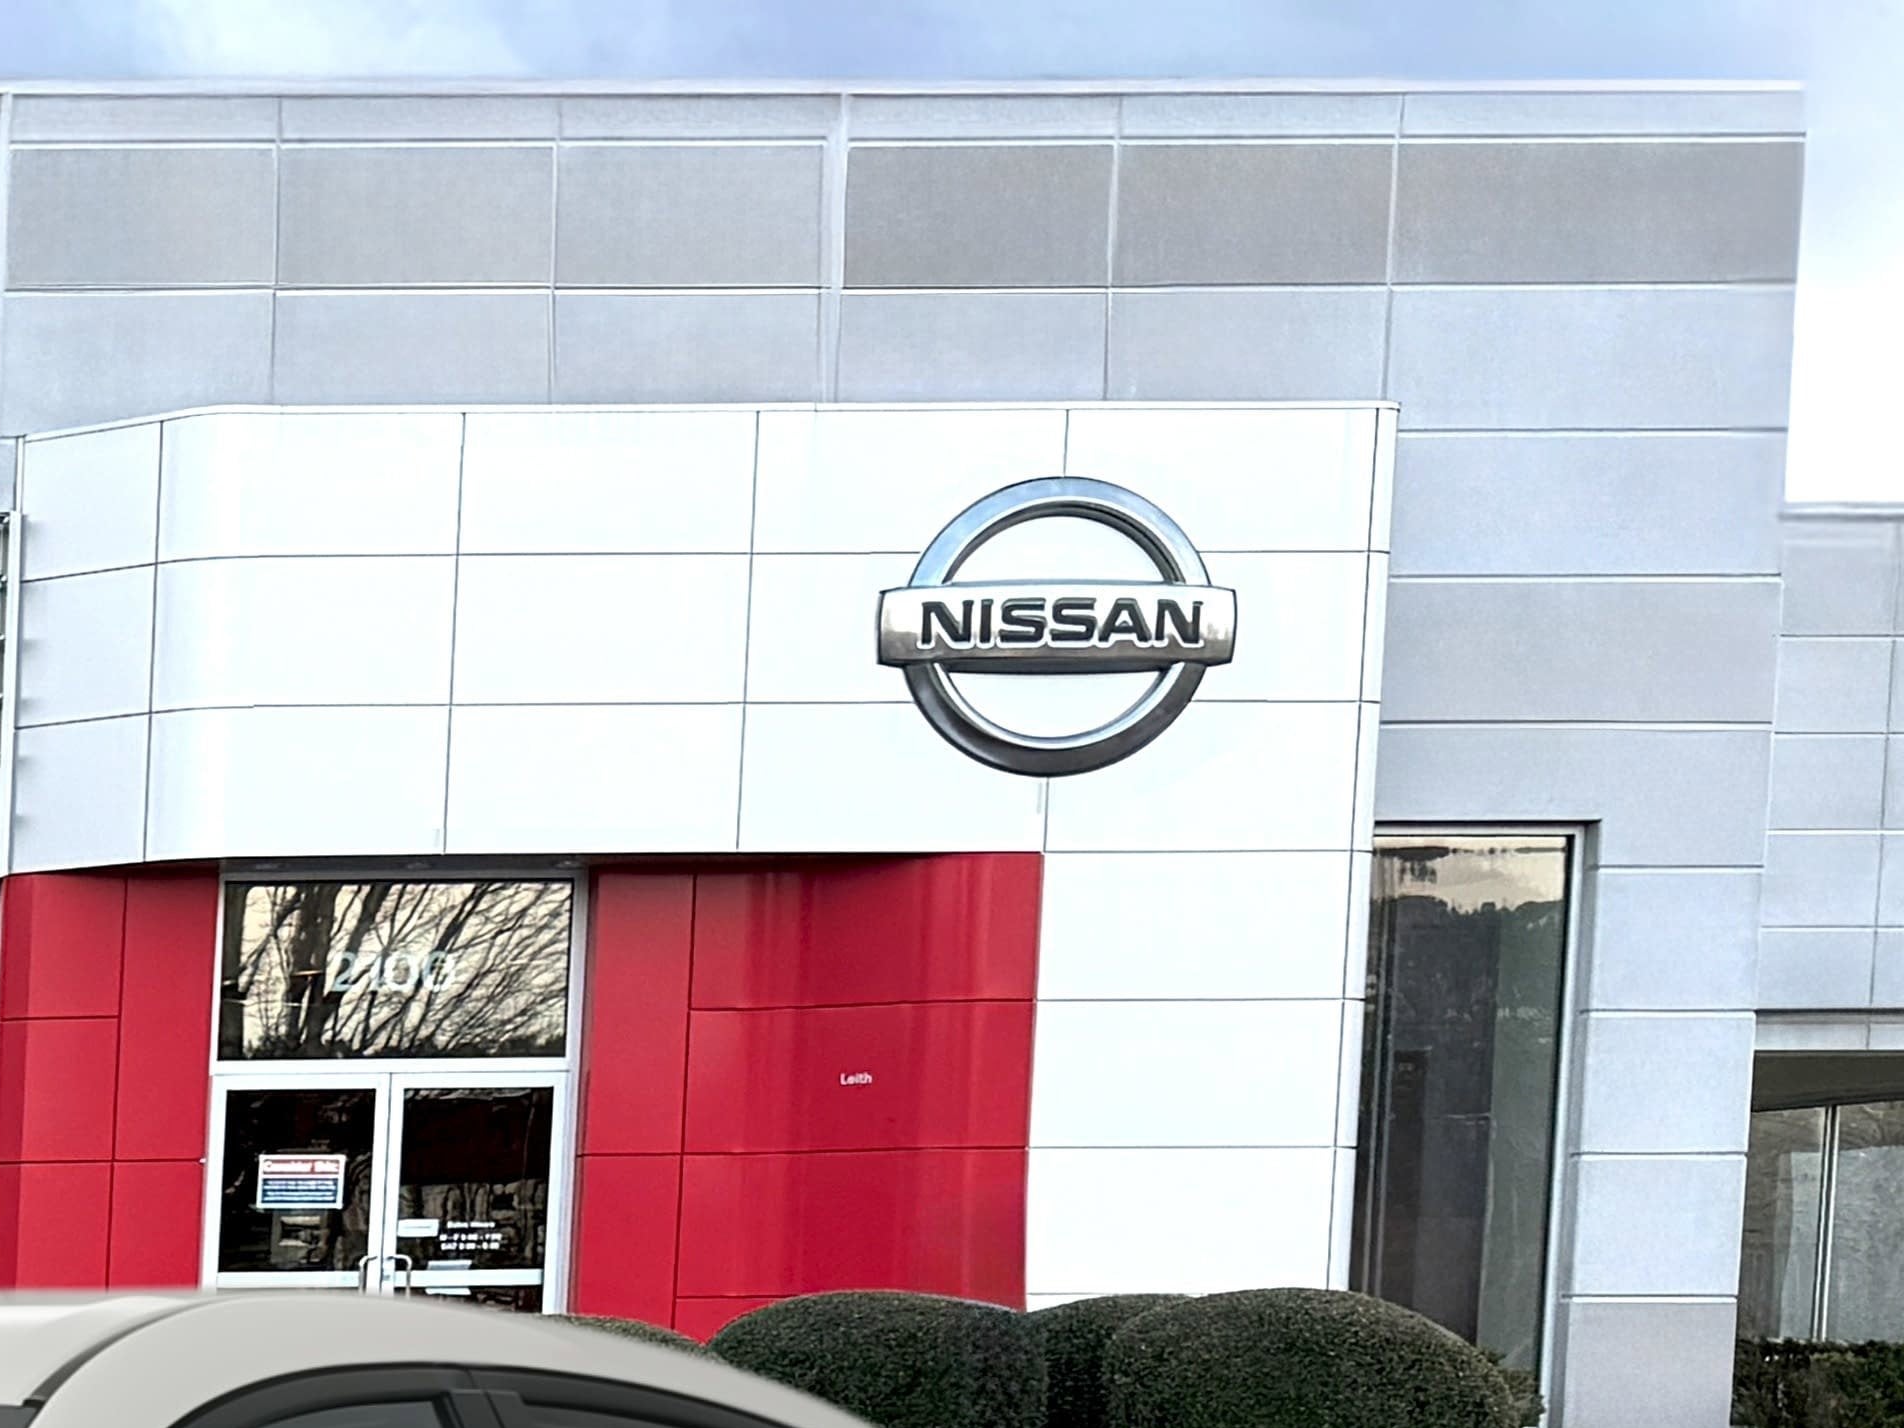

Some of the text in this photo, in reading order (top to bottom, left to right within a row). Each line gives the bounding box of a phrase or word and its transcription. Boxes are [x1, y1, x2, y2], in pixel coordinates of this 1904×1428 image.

[920, 597, 1204, 647] NISSAN
[331, 950, 456, 992] 2100
[840, 1072, 873, 1085] Leith
